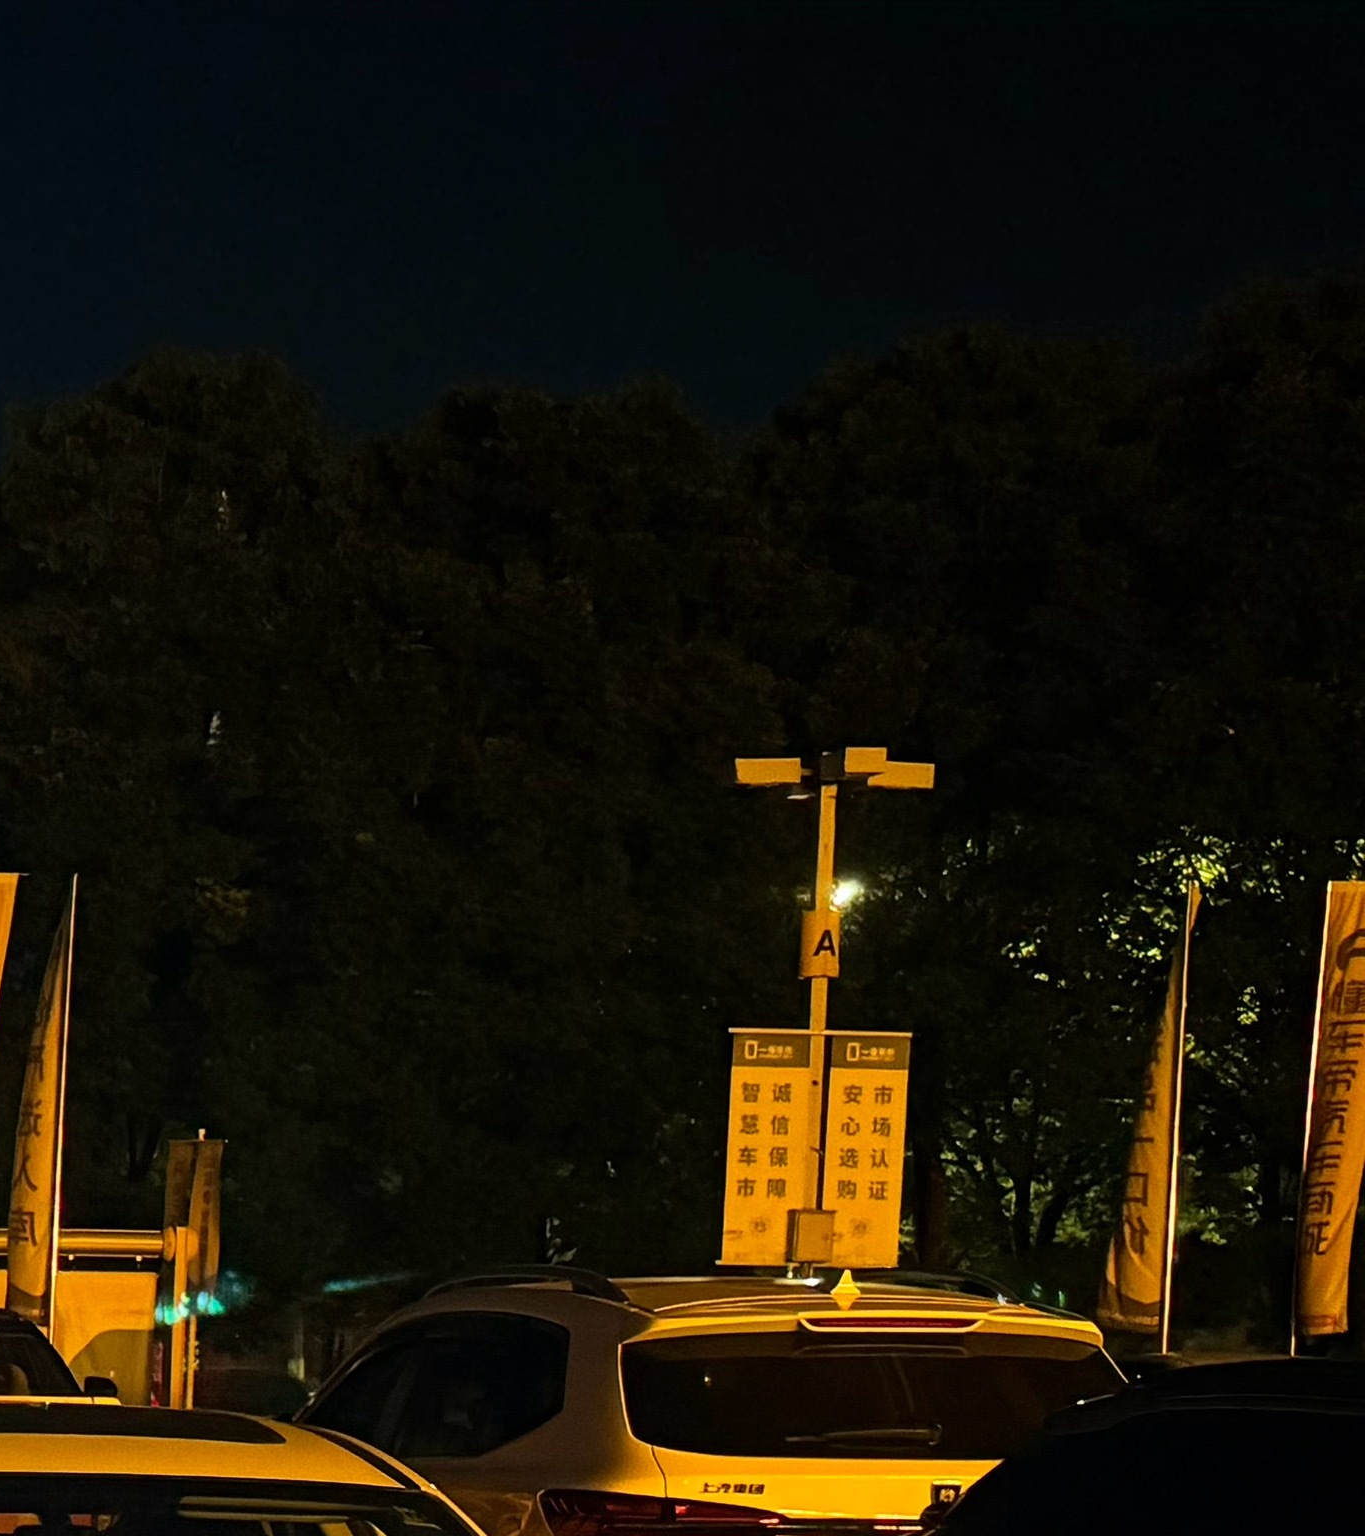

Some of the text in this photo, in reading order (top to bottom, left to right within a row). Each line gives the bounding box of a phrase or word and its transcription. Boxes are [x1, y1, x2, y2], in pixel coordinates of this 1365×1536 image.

[812, 929, 837, 957] A
[836, 1085, 864, 1200] 安心选购
[867, 1086, 894, 1201] 市场认证
